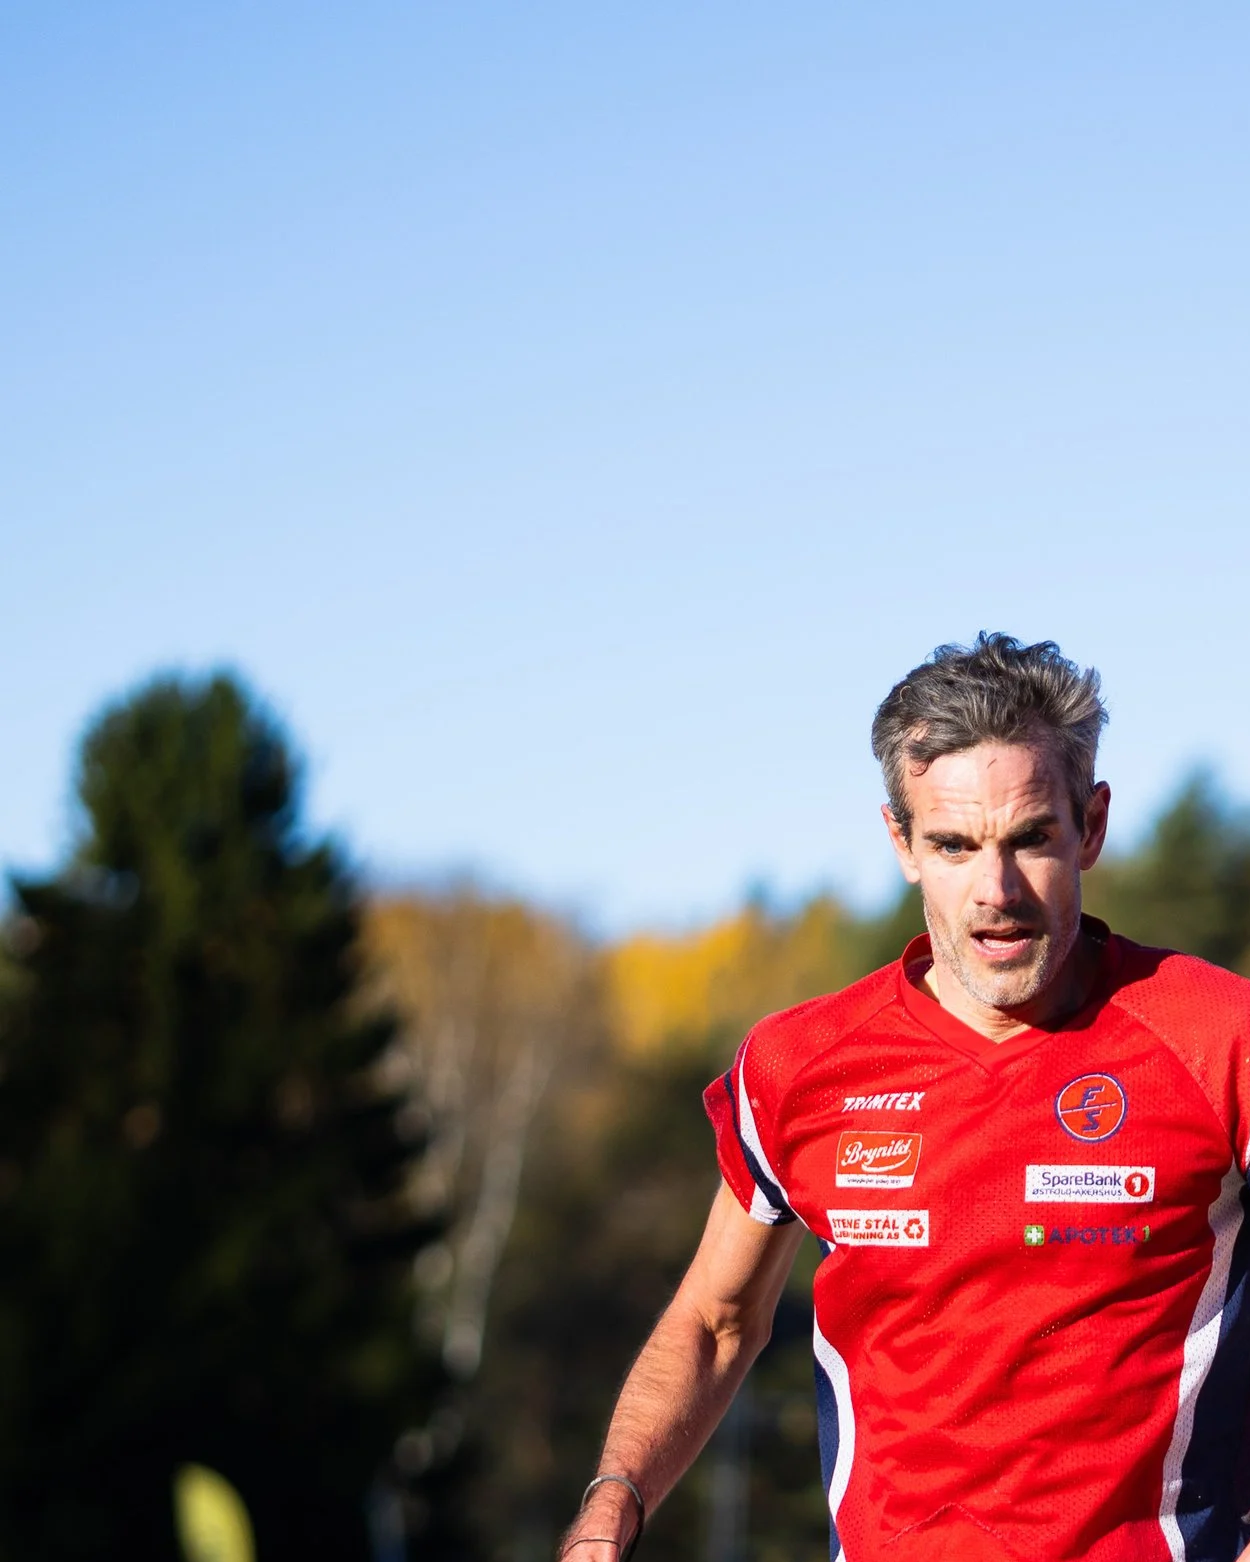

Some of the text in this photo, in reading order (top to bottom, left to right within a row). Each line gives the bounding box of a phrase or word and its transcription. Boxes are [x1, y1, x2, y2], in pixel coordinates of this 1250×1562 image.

[842, 1092, 925, 1113] TRIMTEX
[841, 1139, 912, 1170] Brynild
[1042, 1171, 1122, 1187] SpareBank
[864, 1215, 899, 1230] STÅL
[1048, 1225, 1151, 1244] APOTEK 1
